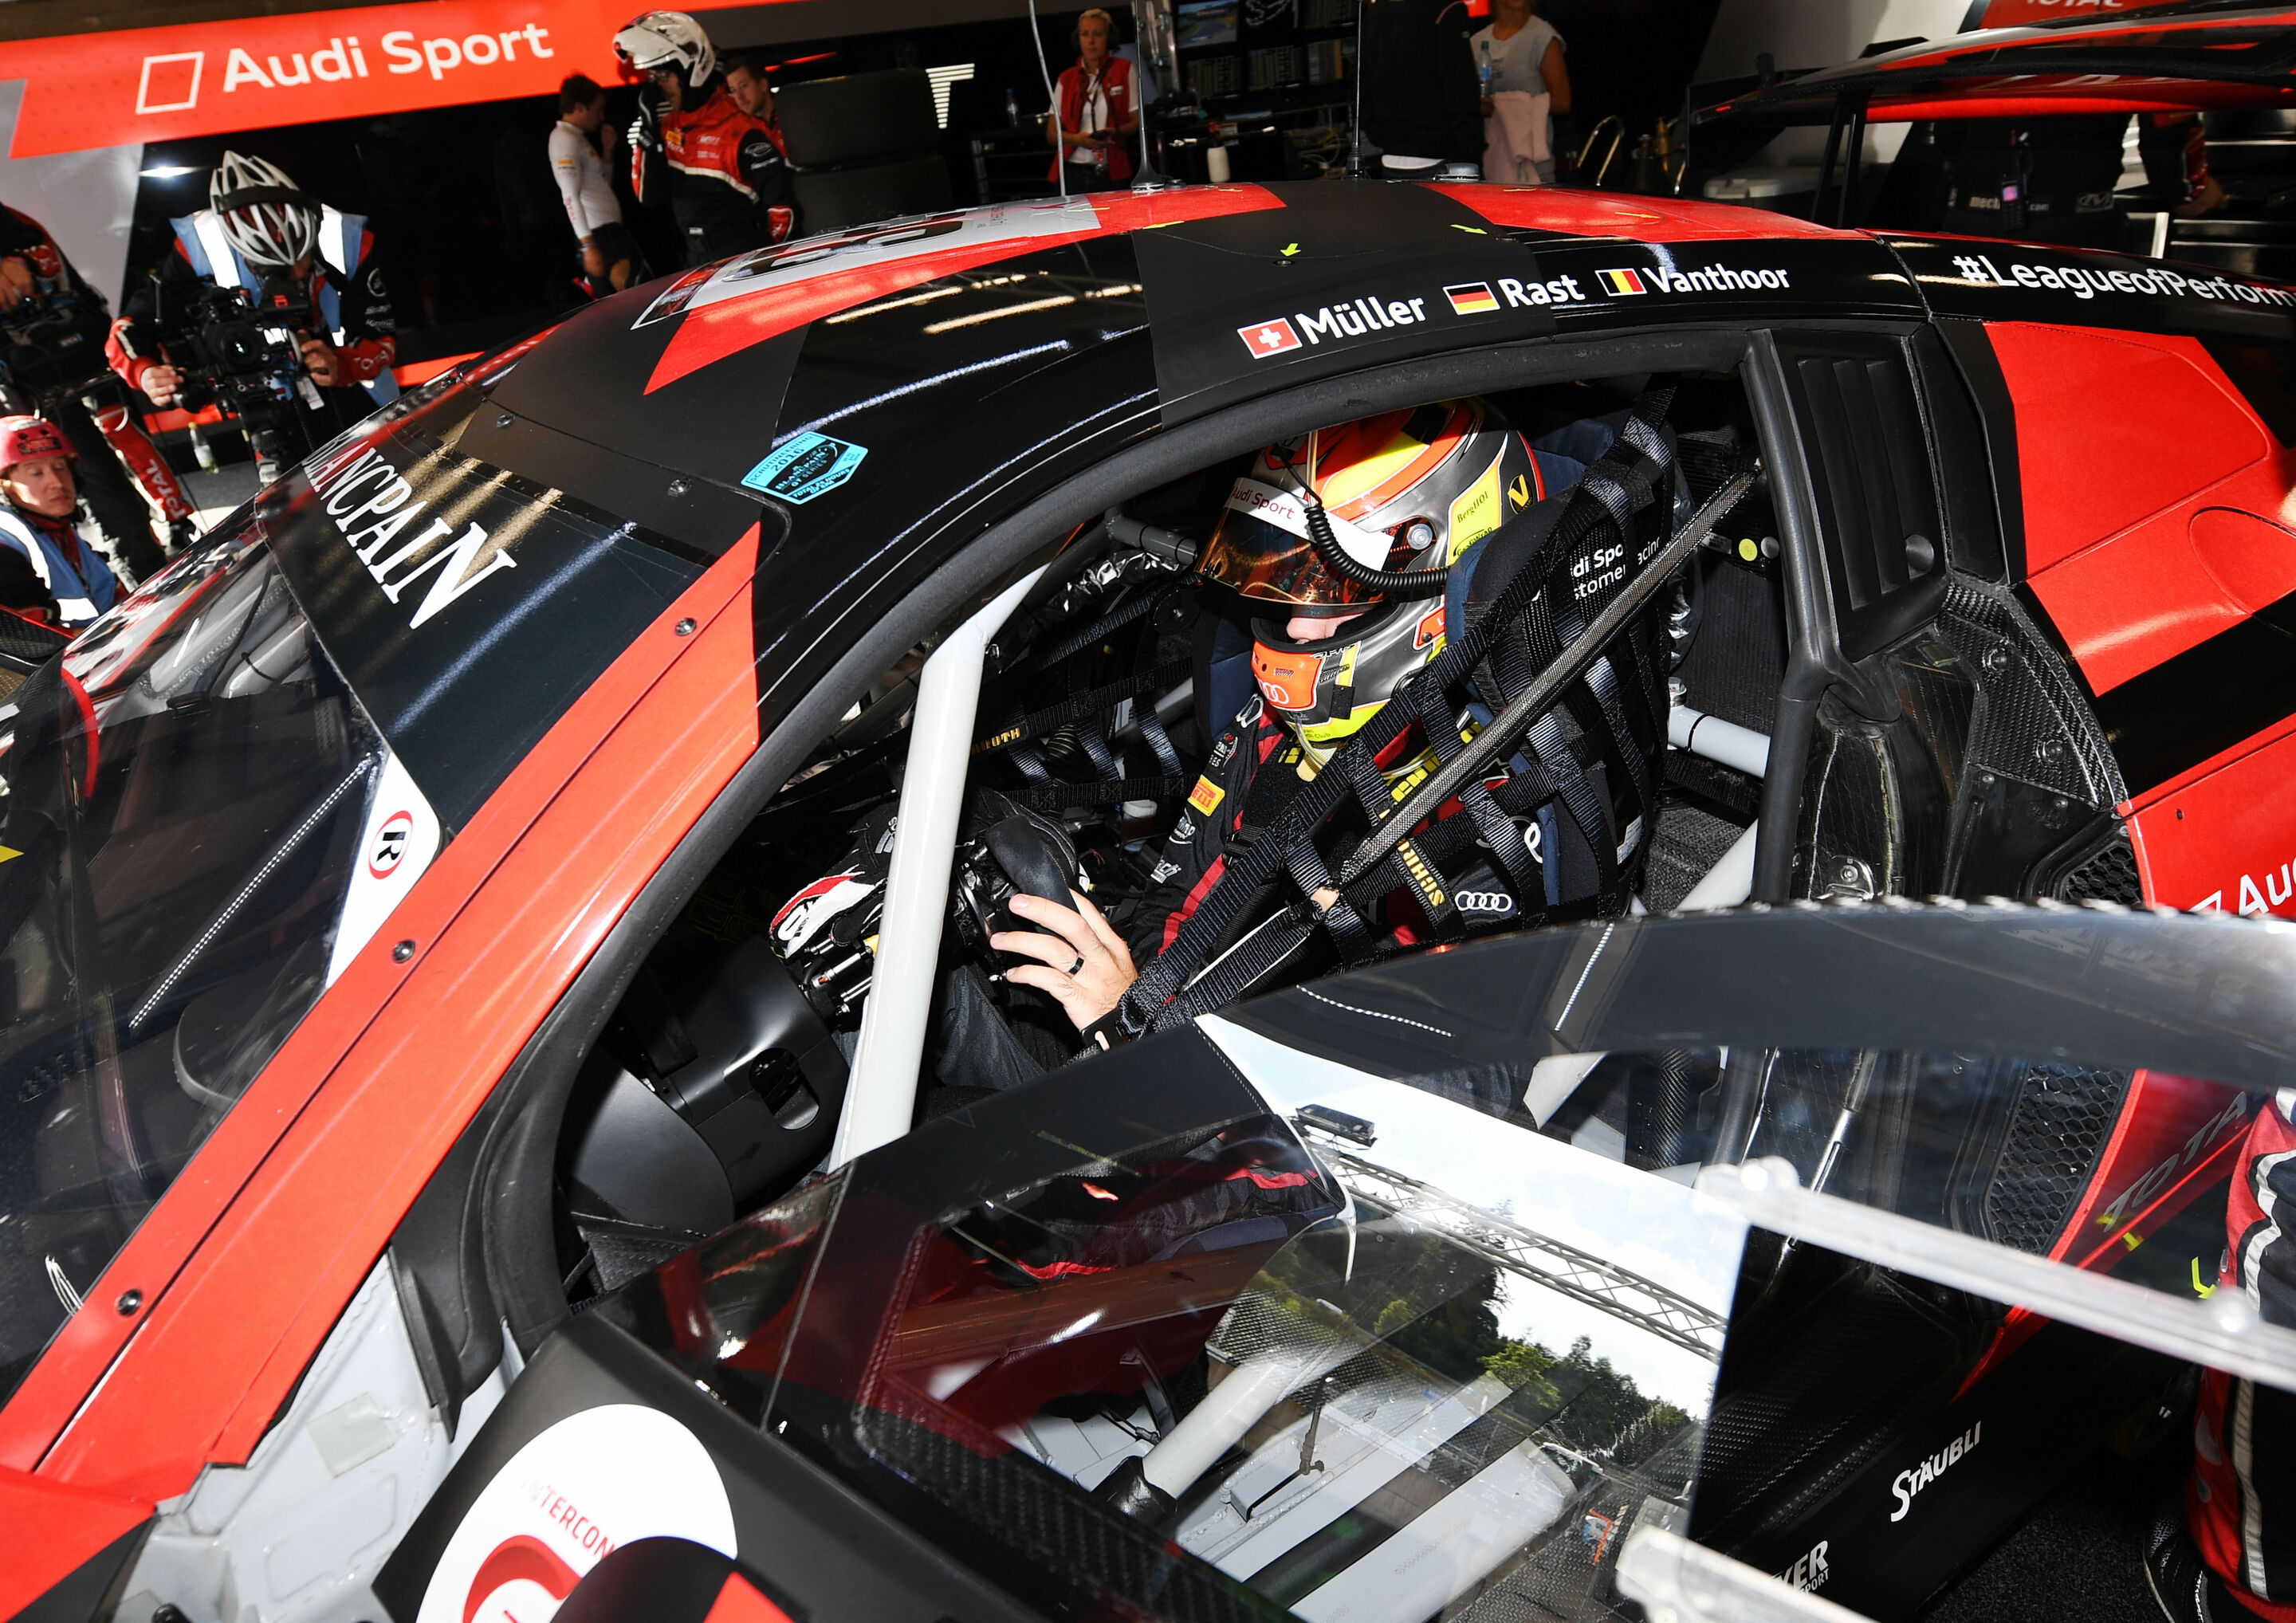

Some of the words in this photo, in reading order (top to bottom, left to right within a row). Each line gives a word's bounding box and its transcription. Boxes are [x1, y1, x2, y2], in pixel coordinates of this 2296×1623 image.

[223, 36, 369, 93] Audi
[381, 23, 555, 81] Sport
[1295, 296, 1426, 345] Müller
[1497, 274, 1586, 308] Rast
[1641, 263, 1791, 293] Vanthoor
[1952, 254, 2296, 307] #LeagueofPerform
[771, 448, 805, 472] 2016
[1231, 486, 1253, 503] Audi
[1251, 492, 1295, 520] Sport
[1594, 544, 1624, 568] Spo
[1890, 1420, 1981, 1523] STÄUBLI
